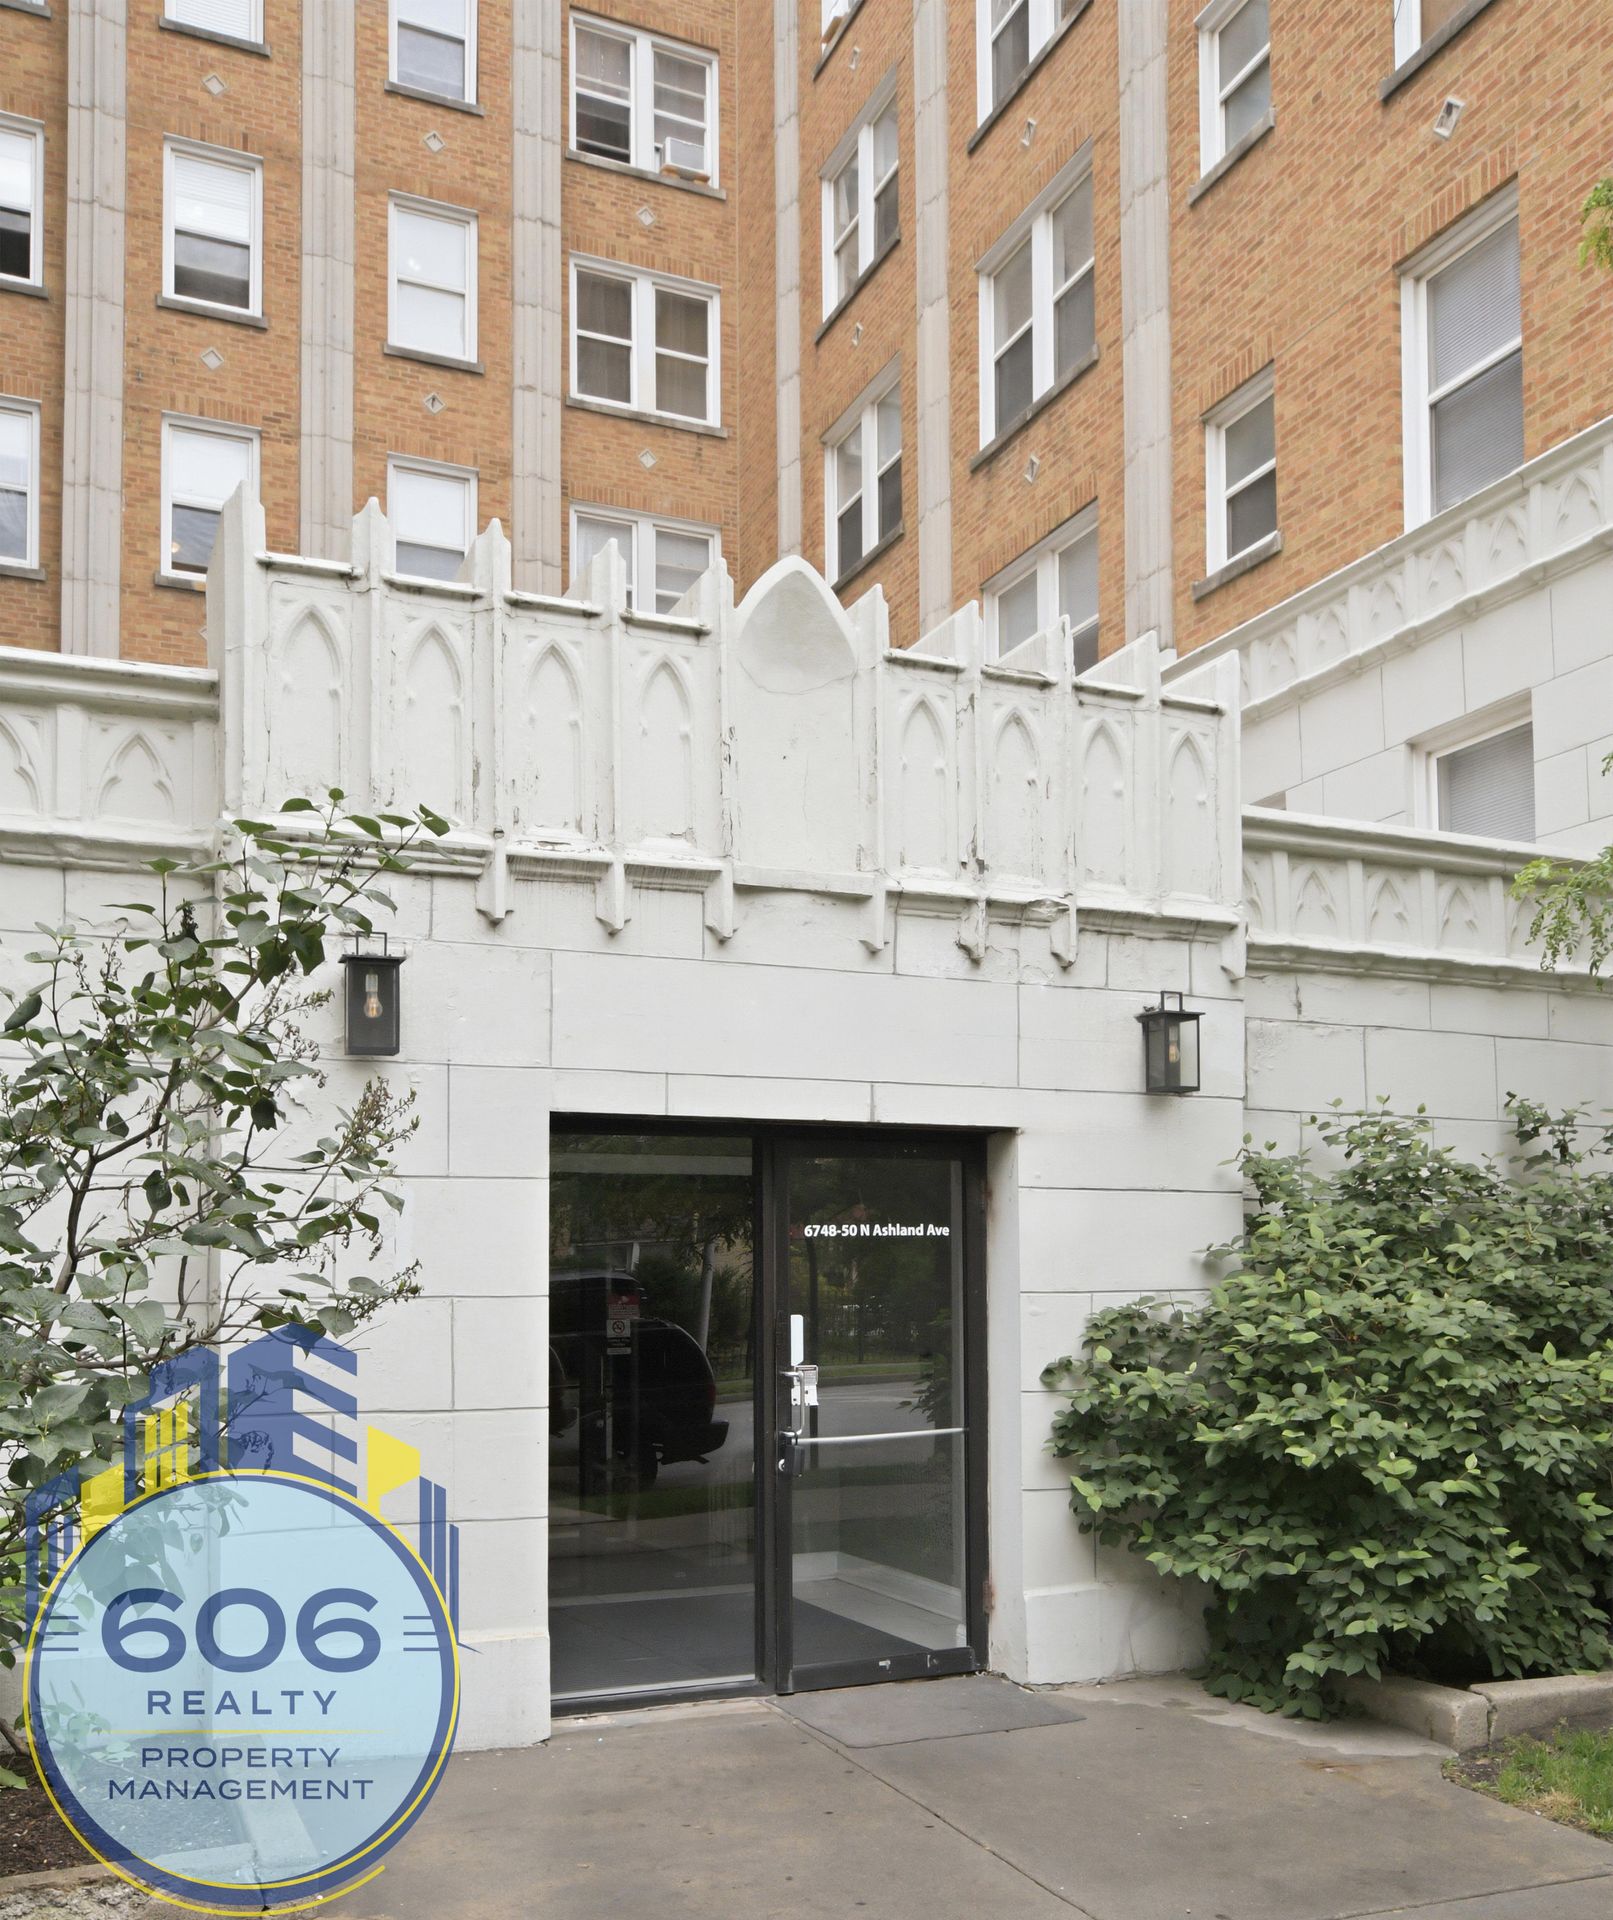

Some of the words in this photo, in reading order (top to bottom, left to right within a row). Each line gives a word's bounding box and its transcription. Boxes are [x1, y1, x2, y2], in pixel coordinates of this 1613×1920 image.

[804, 1224, 858, 1237] 6748-50
[860, 1224, 870, 1236] N
[873, 1223, 924, 1236] Ashland
[926, 1224, 950, 1236] Ave
